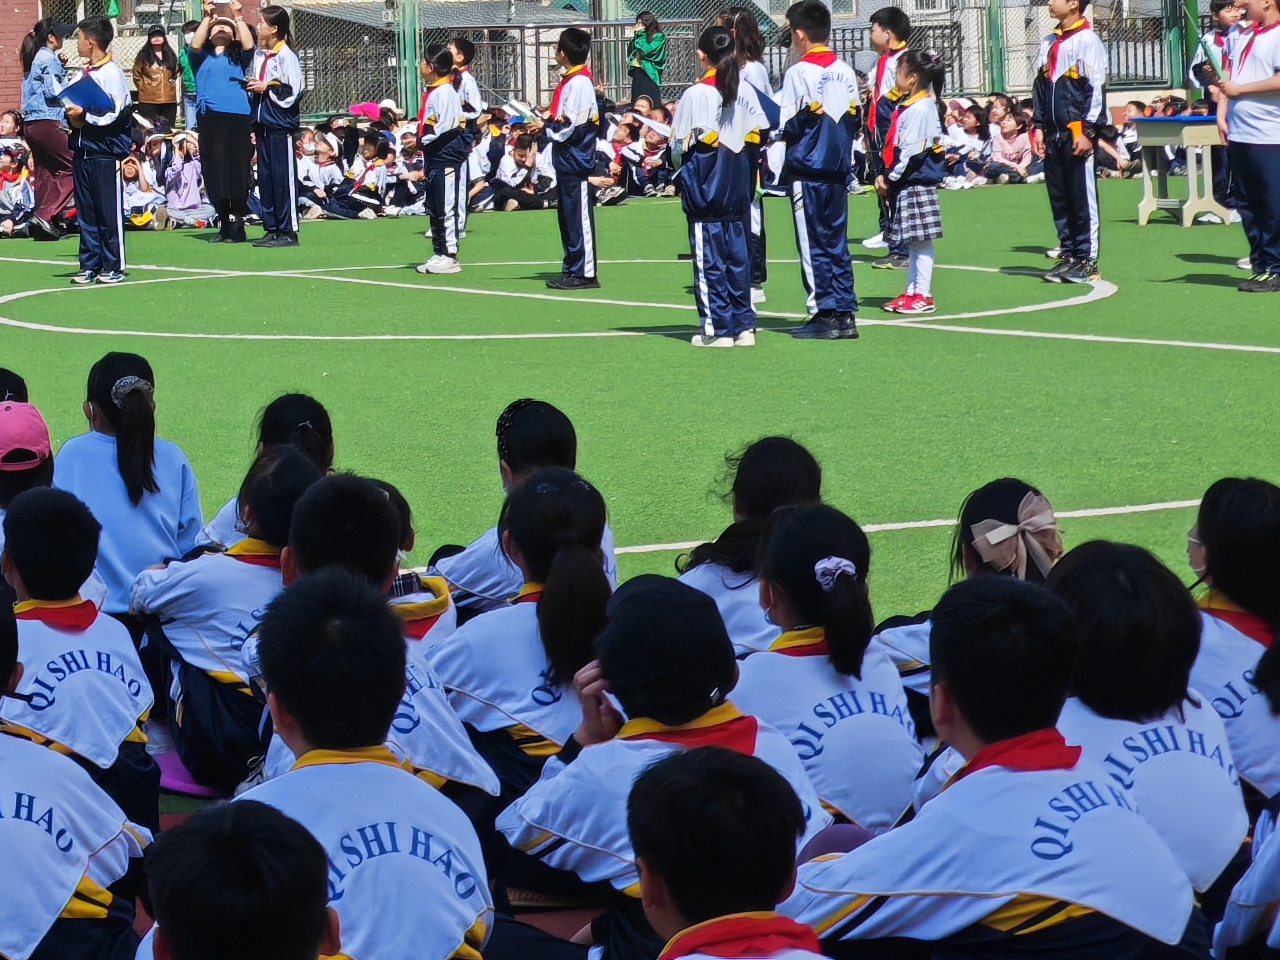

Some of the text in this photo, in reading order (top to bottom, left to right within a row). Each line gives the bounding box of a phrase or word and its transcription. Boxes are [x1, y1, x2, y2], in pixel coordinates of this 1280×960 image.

[27, 649, 141, 711] QI SHI HAO
[531, 670, 563, 707] Q
[1211, 681, 1248, 719] QI
[791, 721, 824, 761] QI
[813, 690, 866, 728] SHI
[1123, 725, 1182, 764] SHI
[11, 791, 74, 853] HAO
[1030, 780, 1109, 860] QI SHI
[339, 821, 402, 869] SHI
[408, 825, 477, 901] HAO
